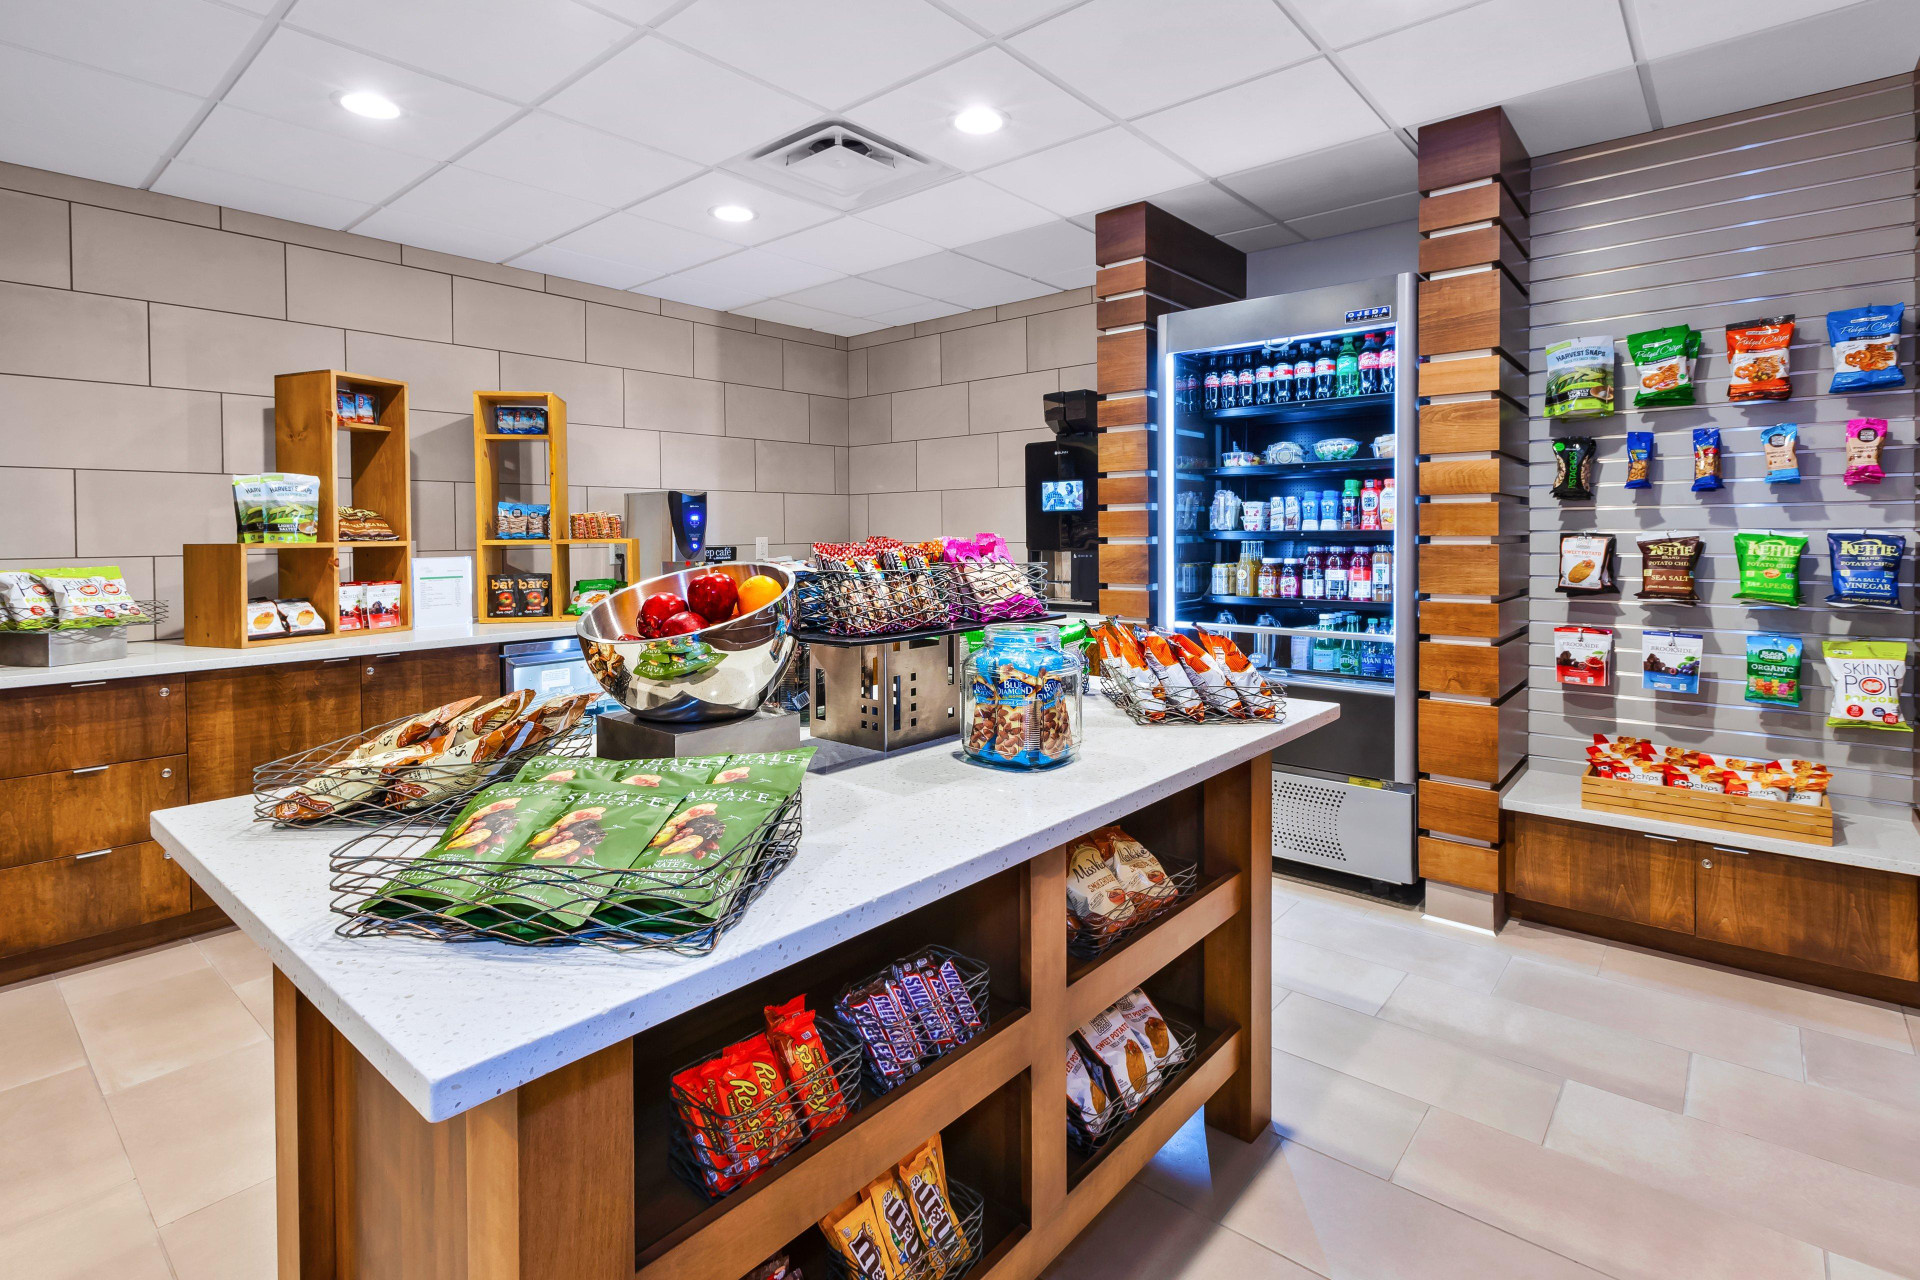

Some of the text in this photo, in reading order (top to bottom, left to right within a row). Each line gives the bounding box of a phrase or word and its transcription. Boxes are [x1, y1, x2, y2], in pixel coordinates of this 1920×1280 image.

[1347, 307, 1388, 318] OJEDA
[1556, 349, 1606, 362] HARVEST SNAPS
[270, 485, 292, 494] HARVEST
[716, 546, 732, 557] café
[518, 578, 549, 590] bare
[1844, 582, 1892, 591] VINEGAR
[1751, 664, 1795, 674] ORGANIC
[1843, 661, 1900, 676] SKINNY
[1844, 675, 1899, 697] POP
[622, 757, 713, 769] SAHALE
[565, 791, 664, 808] SAHALE
[577, 799, 639, 807] SNACKS
[1095, 1036, 1113, 1052] SWEET
